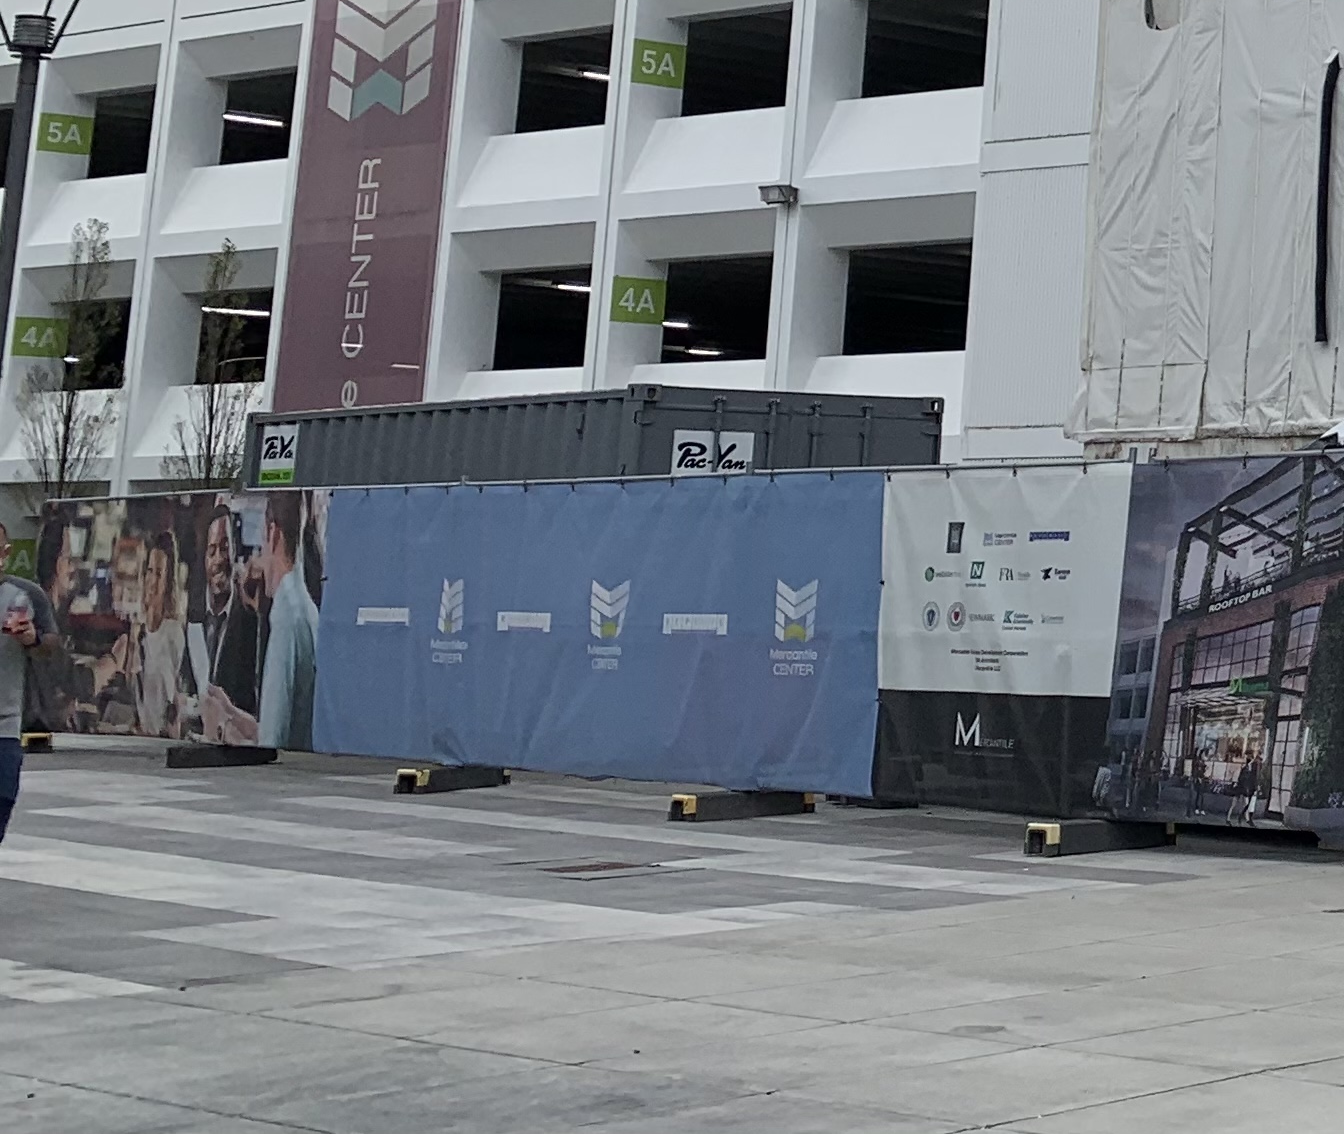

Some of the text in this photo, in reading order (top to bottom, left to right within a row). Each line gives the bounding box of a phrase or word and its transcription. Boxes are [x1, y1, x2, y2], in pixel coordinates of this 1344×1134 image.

[642, 49, 676, 78] 5A
[46, 122, 82, 146] 5A
[341, 157, 382, 358] CENTER
[618, 287, 656, 314] 4A
[20, 325, 58, 349] 4A
[1208, 584, 1273, 614] ROOFTOP BAR
[773, 662, 815, 676] CENTER
